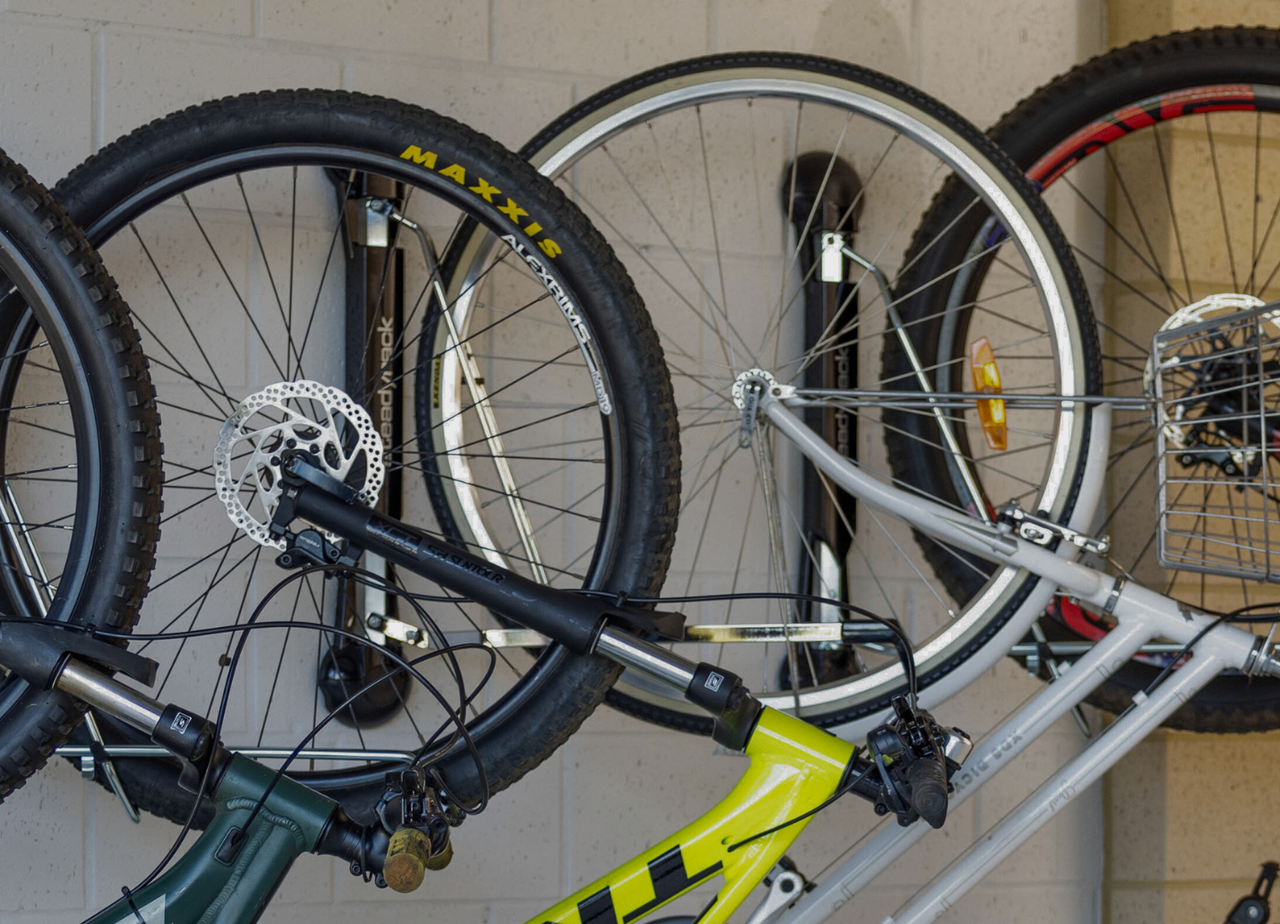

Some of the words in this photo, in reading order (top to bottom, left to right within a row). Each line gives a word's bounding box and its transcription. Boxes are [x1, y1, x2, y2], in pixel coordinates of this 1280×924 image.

[400, 145, 562, 259] MAXXIS
[501, 234, 591, 343] ALEXRIMS
[450, 555, 506, 584] SUNTOUR
